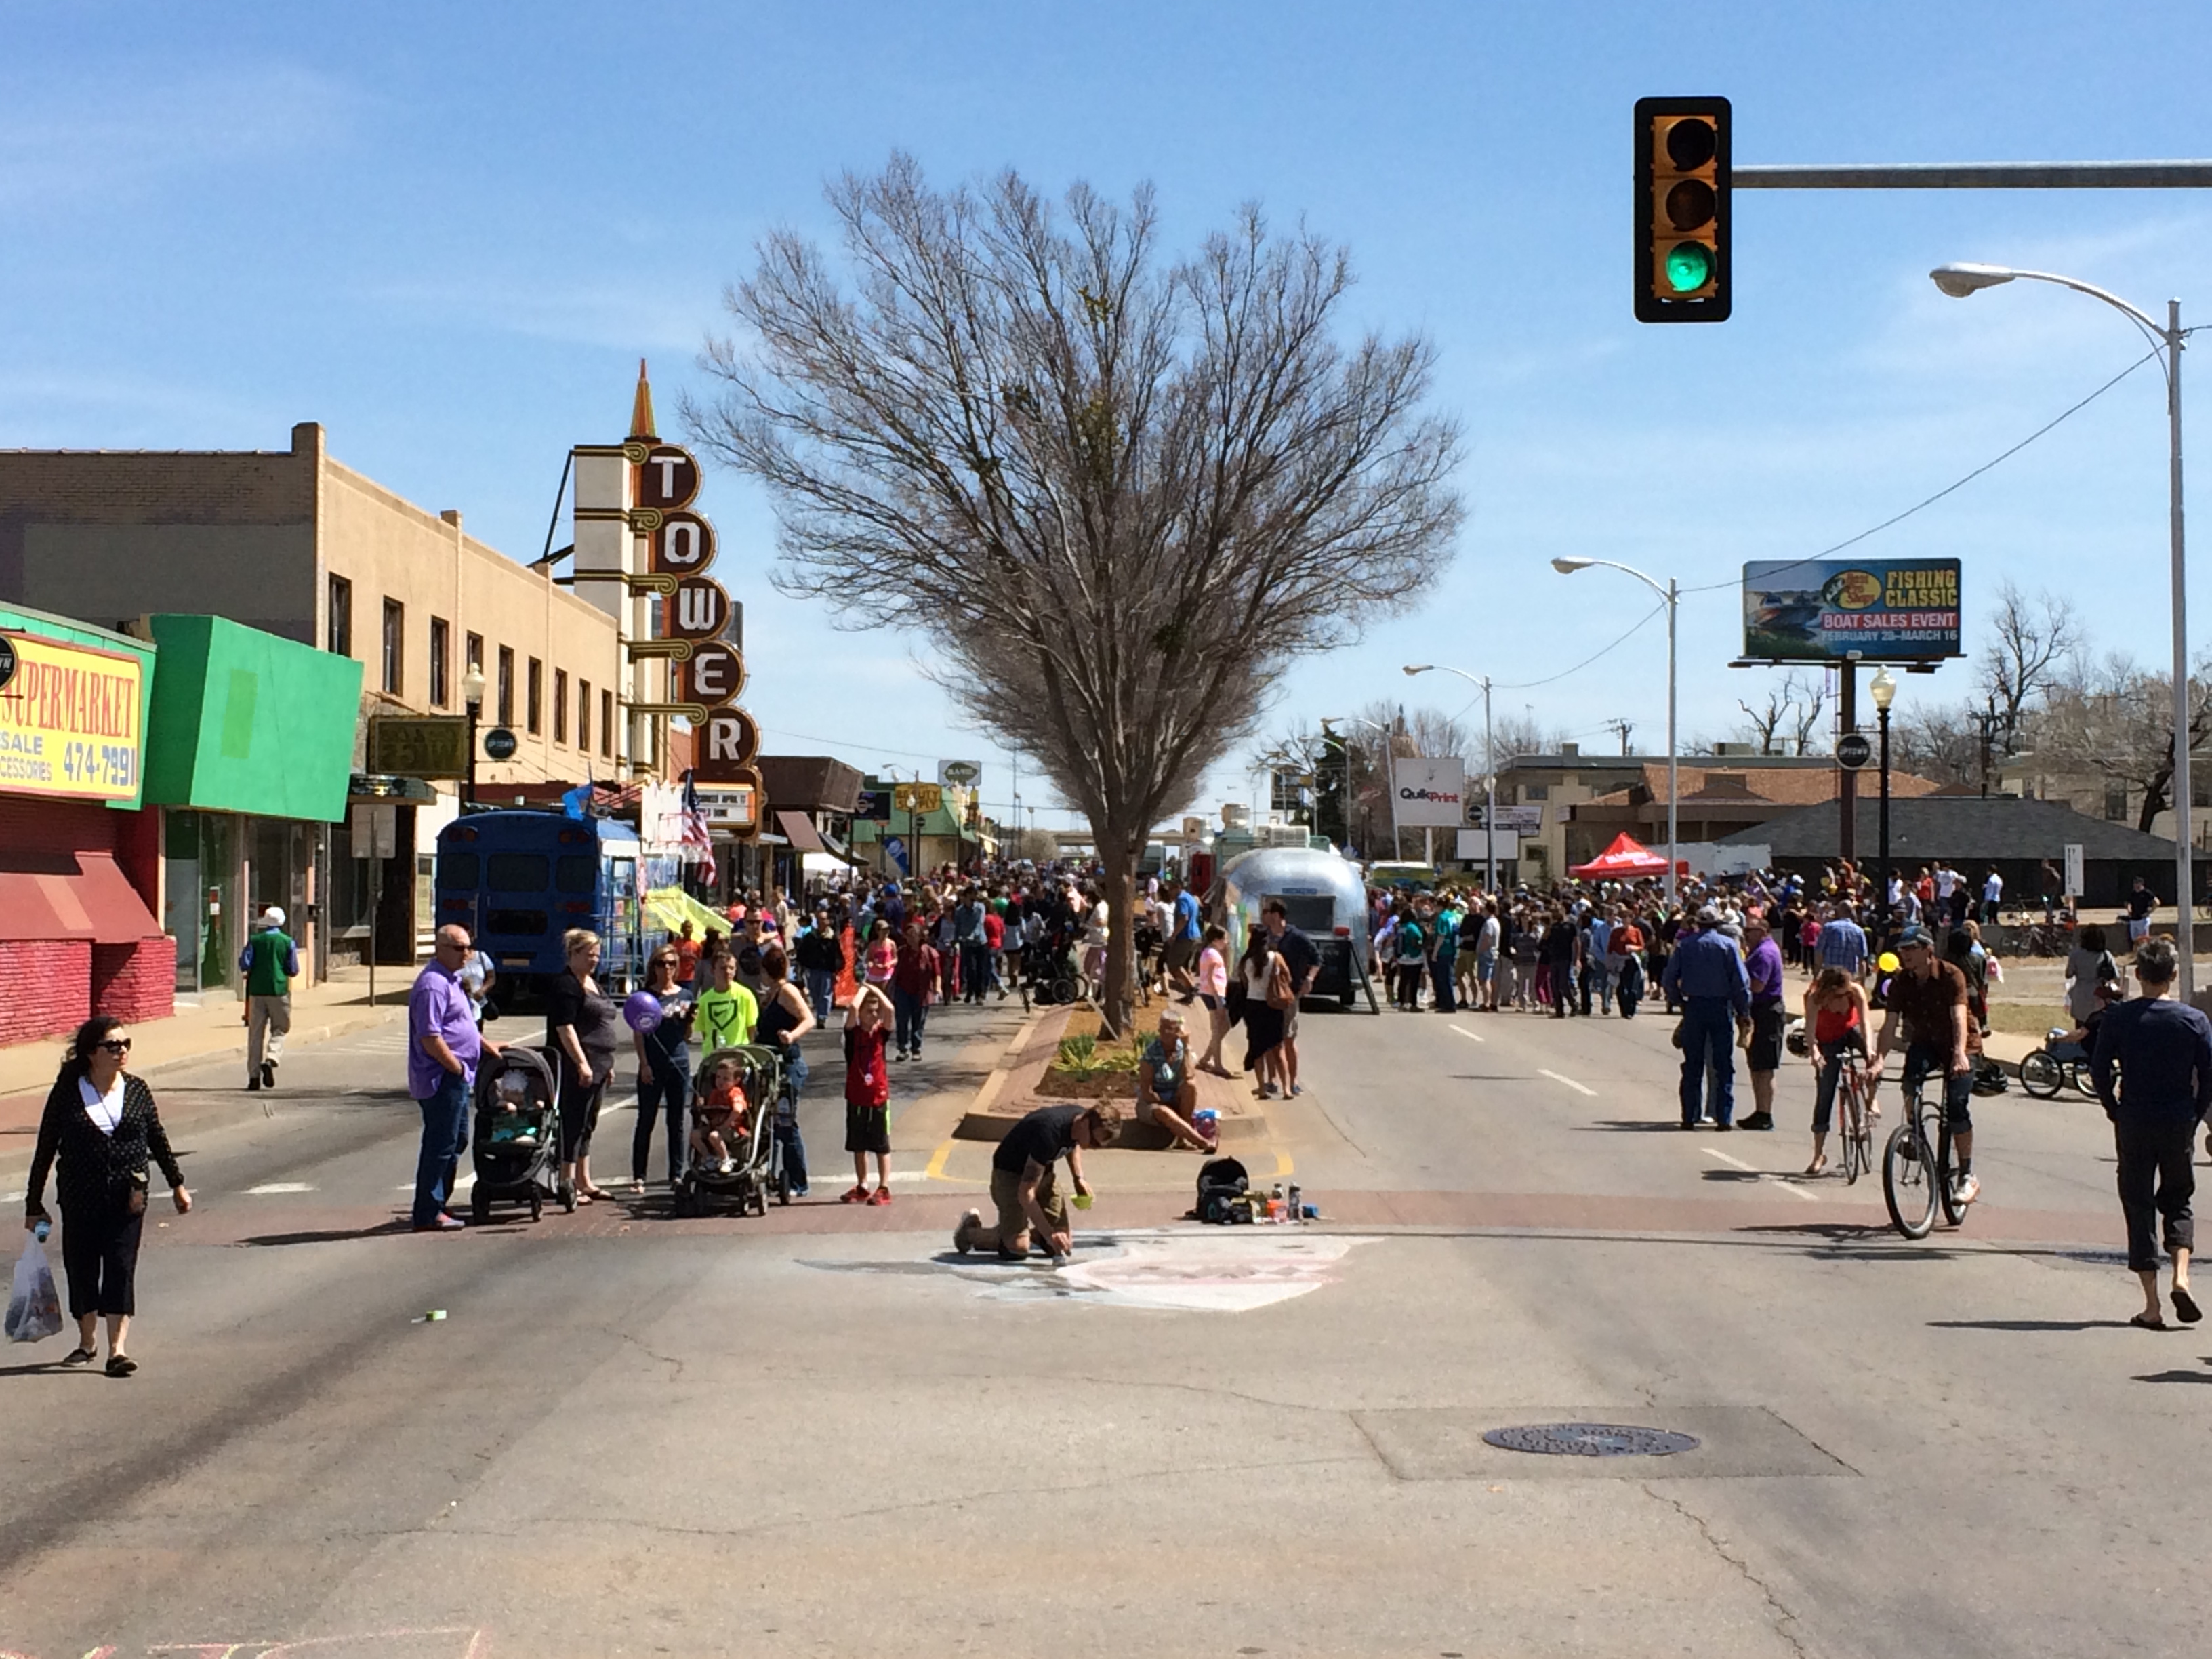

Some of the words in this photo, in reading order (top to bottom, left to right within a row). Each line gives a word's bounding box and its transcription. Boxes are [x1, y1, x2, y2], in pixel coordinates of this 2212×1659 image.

[1888, 571, 1956, 588] FISHING
[1886, 589, 1957, 607] CLASSIC
[649, 455, 742, 761] TOWER
[1824, 615, 1860, 628] BOAT
[1864, 614, 1907, 628] SALES
[1912, 613, 1956, 627] EVENT
[1823, 631, 1879, 641] FEBRUARY
[0, 731, 43, 755] SALE
[64, 741, 135, 786] 474-7991
